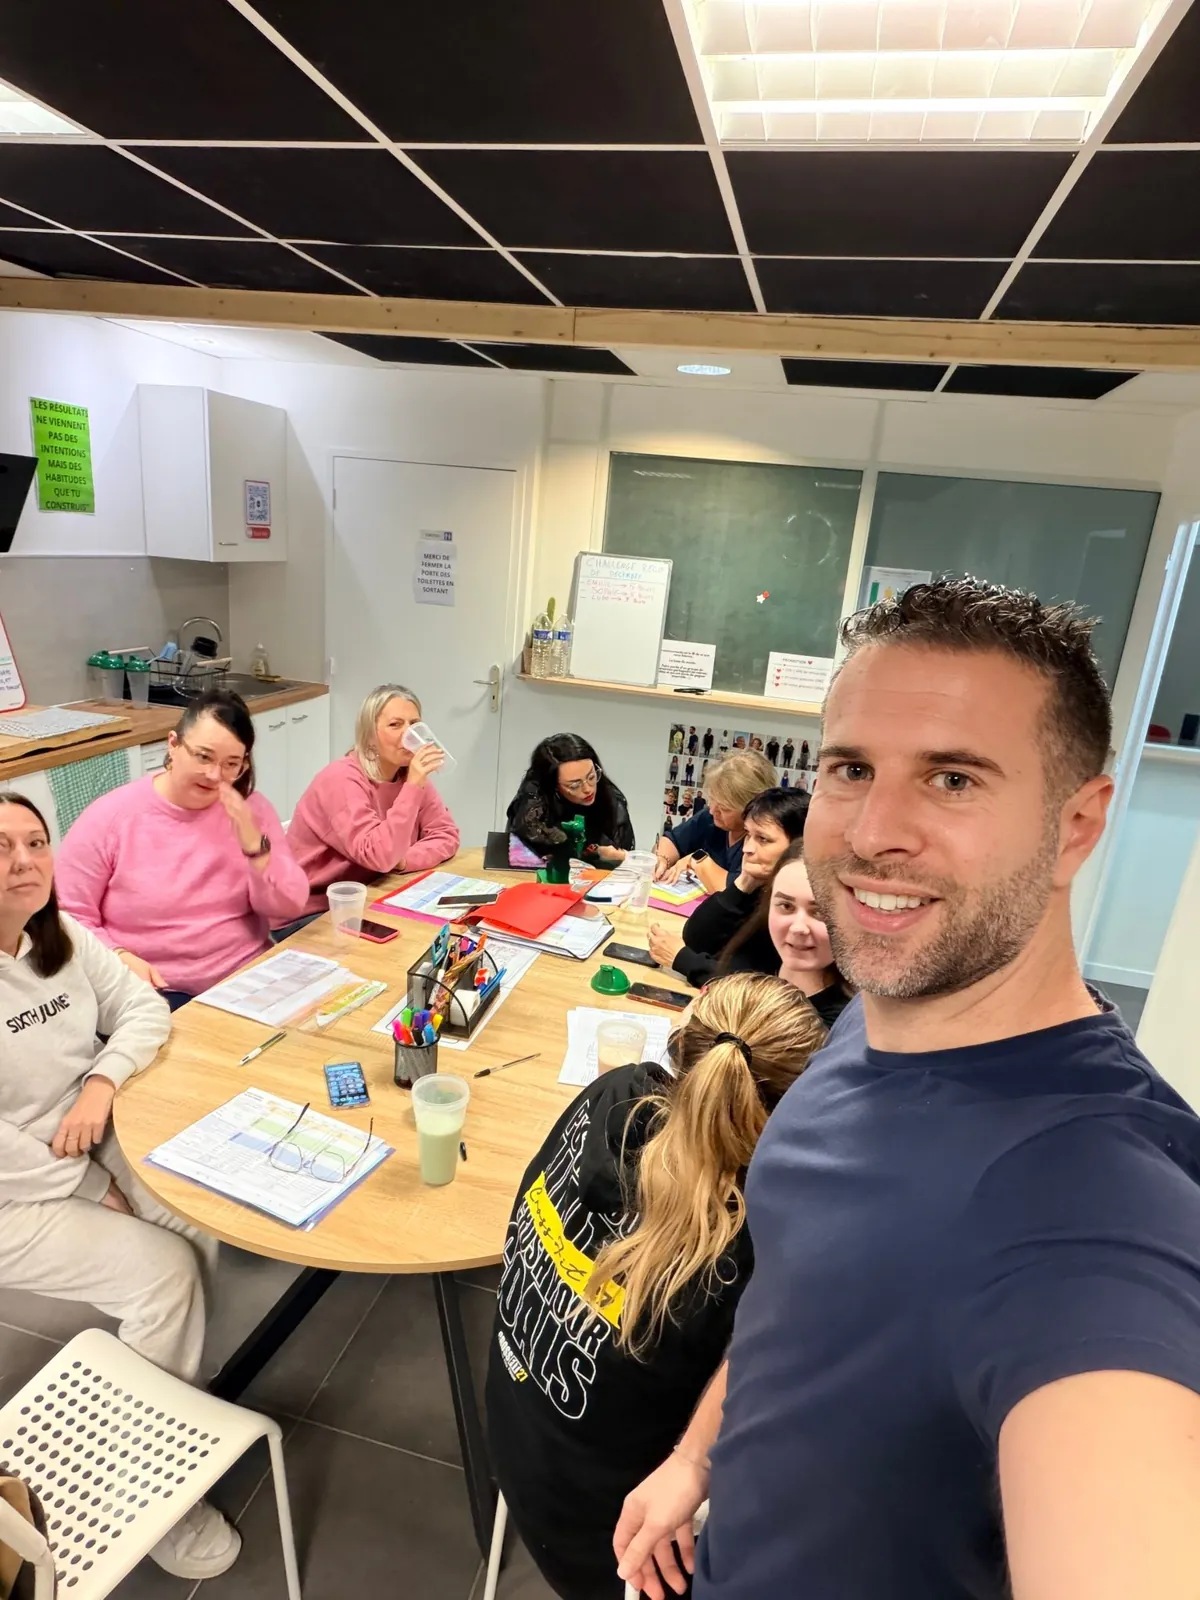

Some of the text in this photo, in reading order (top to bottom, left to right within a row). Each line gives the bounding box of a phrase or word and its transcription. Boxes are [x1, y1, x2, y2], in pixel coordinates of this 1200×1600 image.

[36, 414, 86, 430] NE VIENNENT
[48, 430, 78, 443] PAS DES
[40, 444, 86, 458] INTENTIONS
[48, 459, 82, 471] MAIS DES
[45, 472, 87, 485] HABITUDES
[53, 487, 81, 498] QUE TU
[421, 561, 443, 569] FERMER
[586, 557, 636, 570] CHALLENGE
[421, 569, 439, 577] PORTE
[417, 577, 445, 586] TOILETTES
[422, 586, 448, 594] SORTANT
[6, 994, 70, 1034] SIXTH JUNE
[515, 1368, 528, 1383] 27
